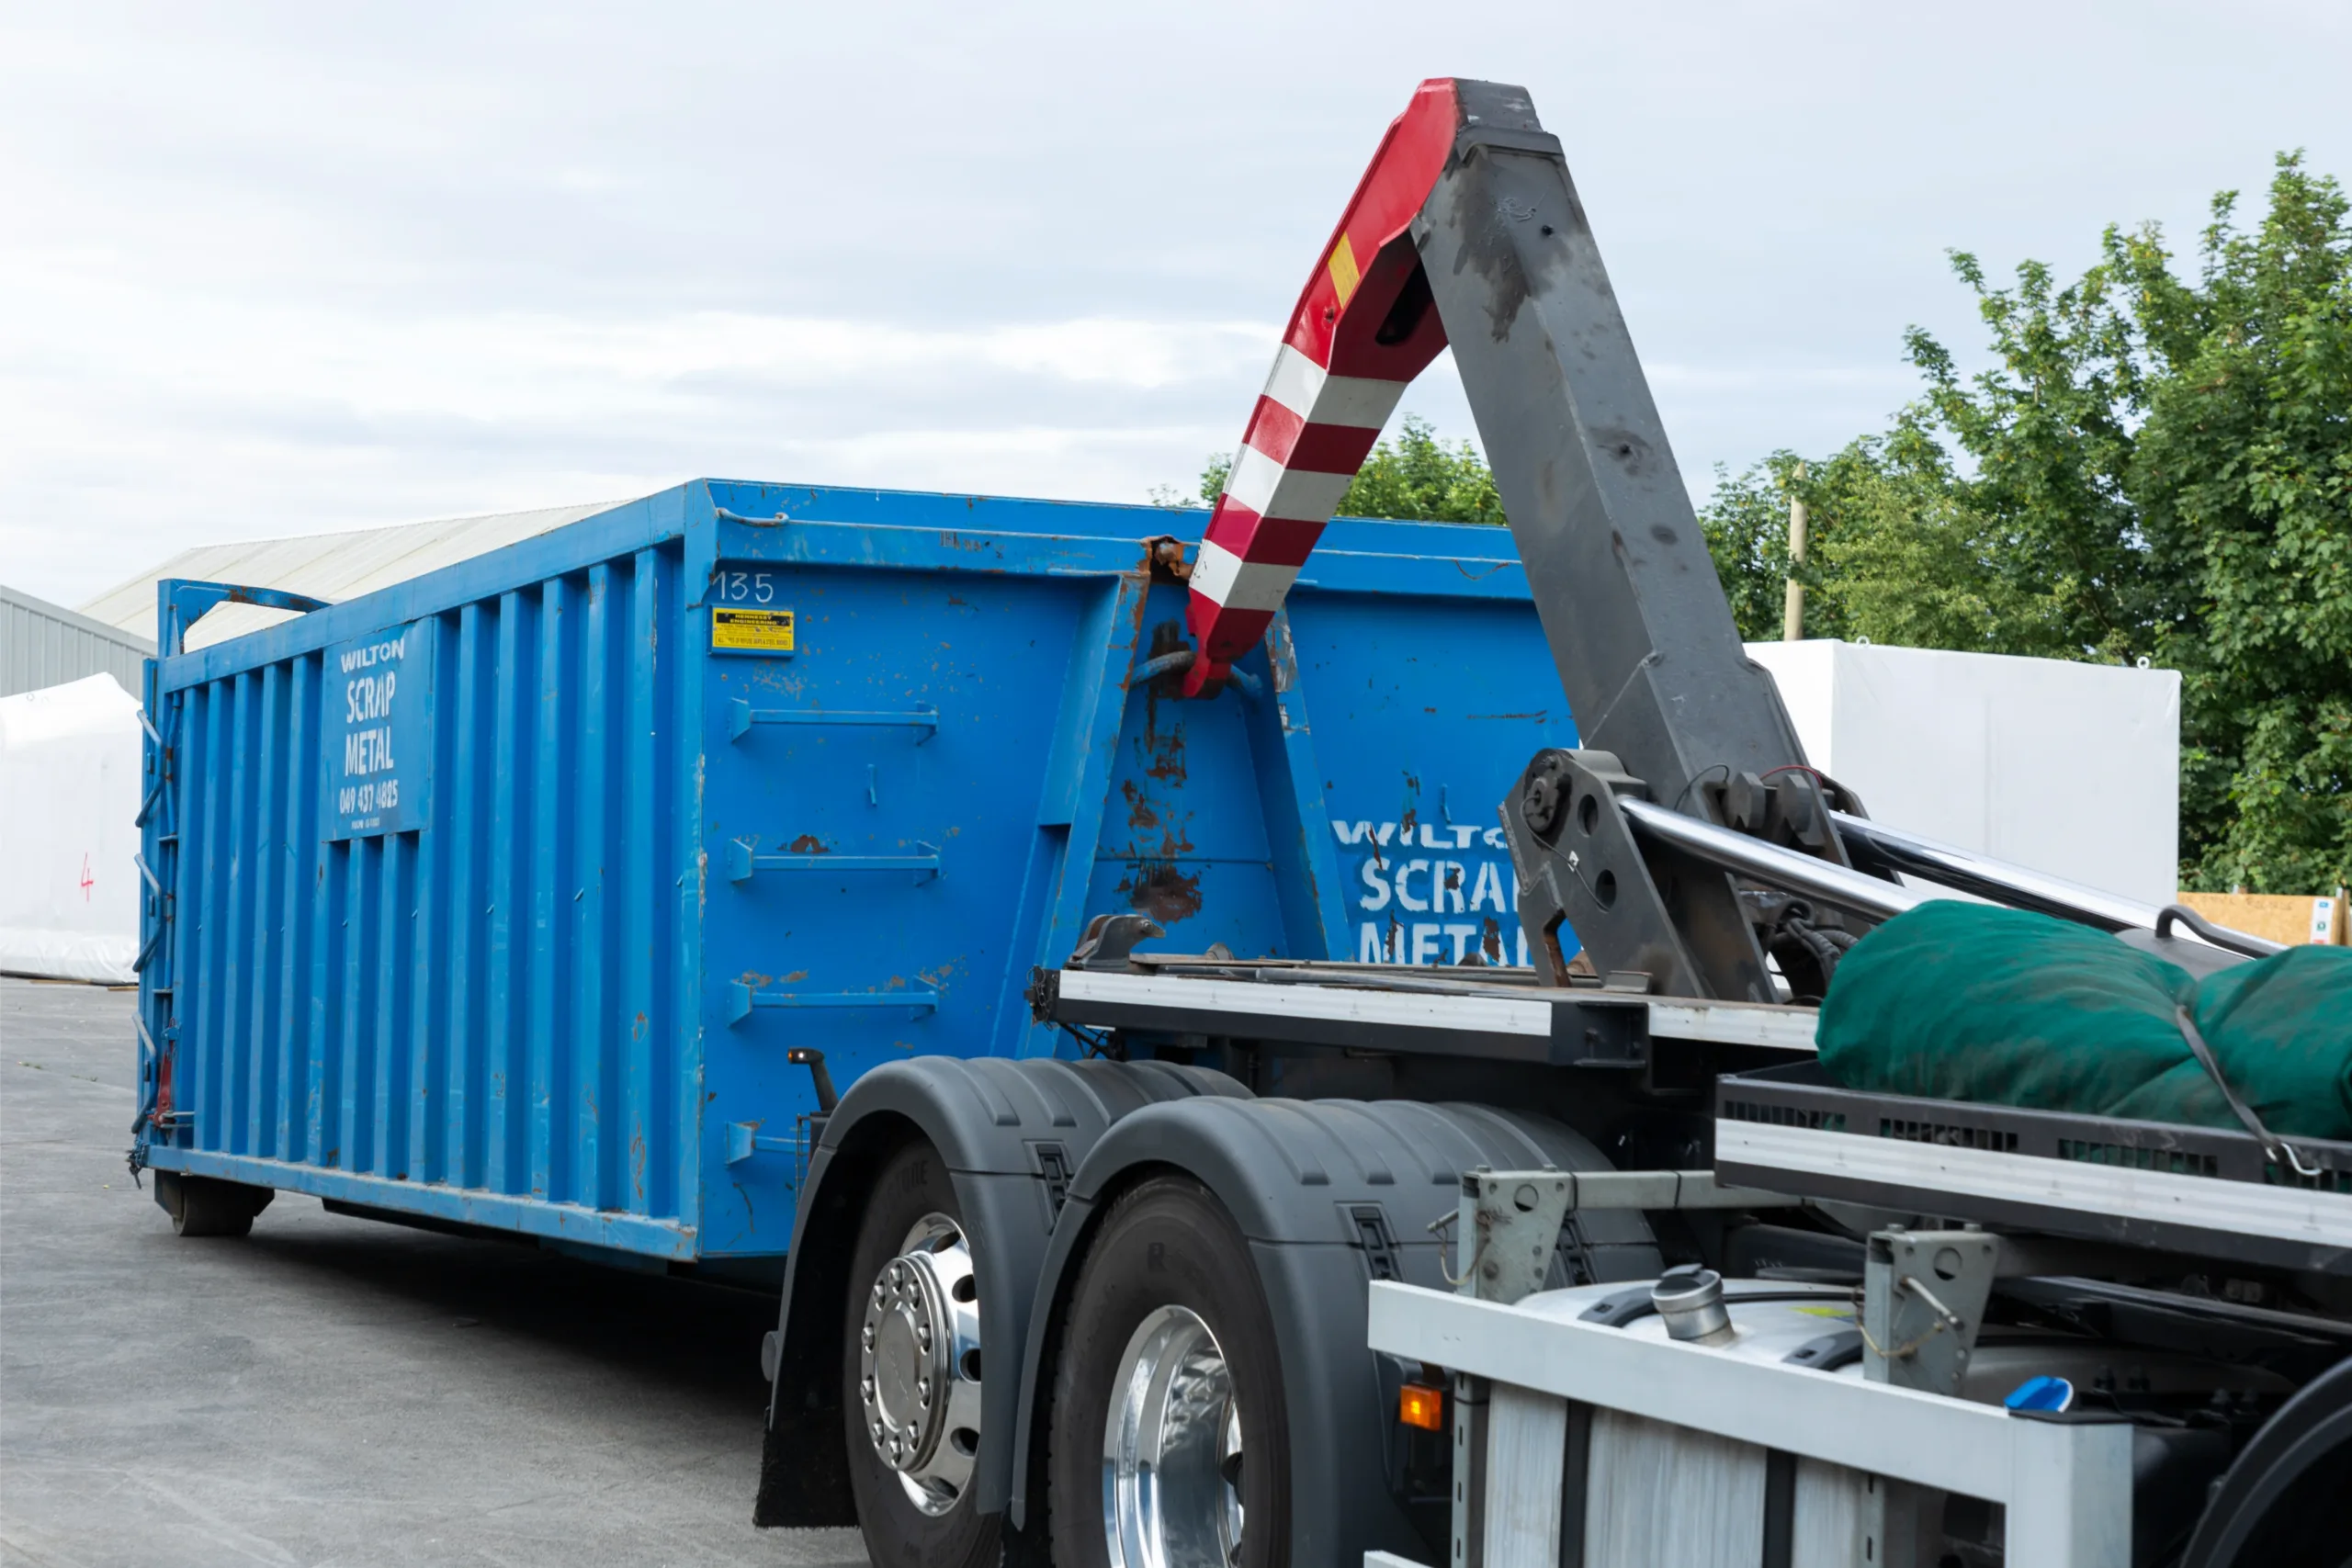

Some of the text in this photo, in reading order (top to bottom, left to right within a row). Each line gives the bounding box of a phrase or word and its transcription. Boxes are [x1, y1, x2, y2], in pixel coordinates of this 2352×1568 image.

[712, 570, 774, 603] 135
[341, 637, 404, 673] WILTON
[346, 671, 396, 724] SCRAP
[345, 726, 394, 776] METAL
[339, 779, 398, 814] 049 437 4825
[1331, 820, 1509, 850] WILTO
[81, 852, 94, 902] 4
[1360, 857, 1518, 913] SCRA
